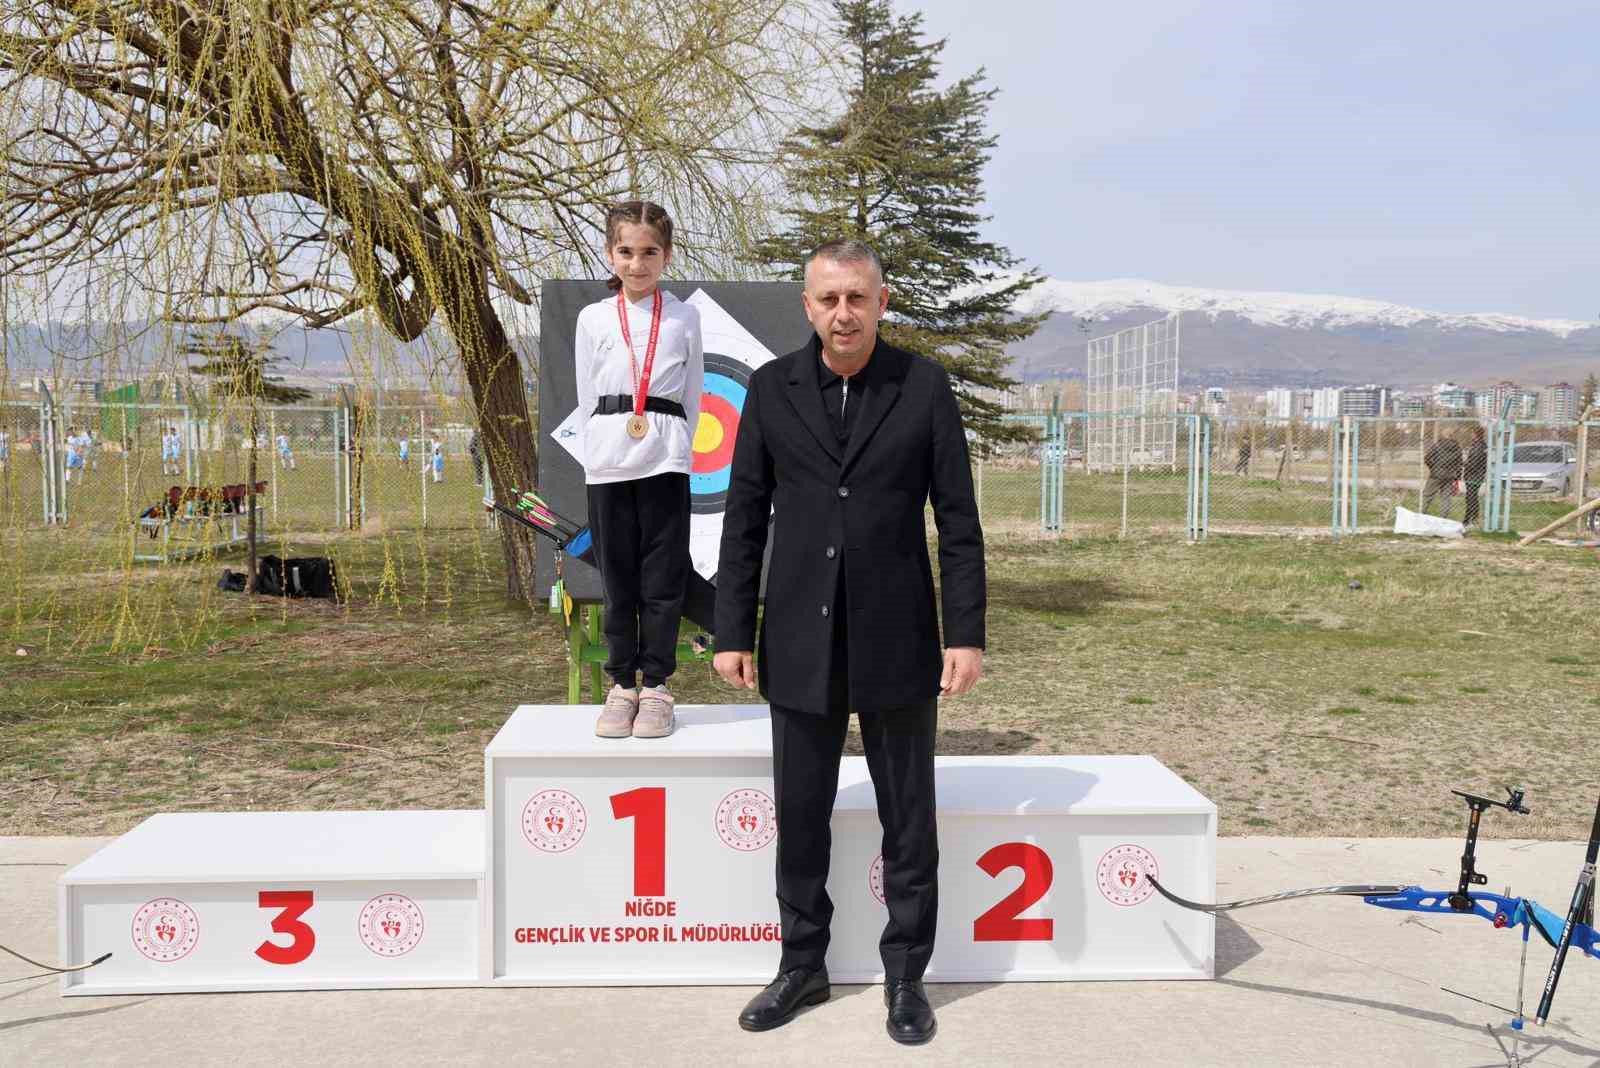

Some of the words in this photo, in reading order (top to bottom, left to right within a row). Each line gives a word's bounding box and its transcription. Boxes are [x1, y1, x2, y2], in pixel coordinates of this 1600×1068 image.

[609, 787, 666, 897] 1
[255, 891, 316, 965] 3
[624, 899, 676, 917] NİĞDE
[973, 842, 1054, 942] 2
[514, 925, 584, 945] GENÇLİK
[590, 928, 610, 943] VE
[614, 927, 658, 943] SPOR
[663, 925, 677, 943] İL
